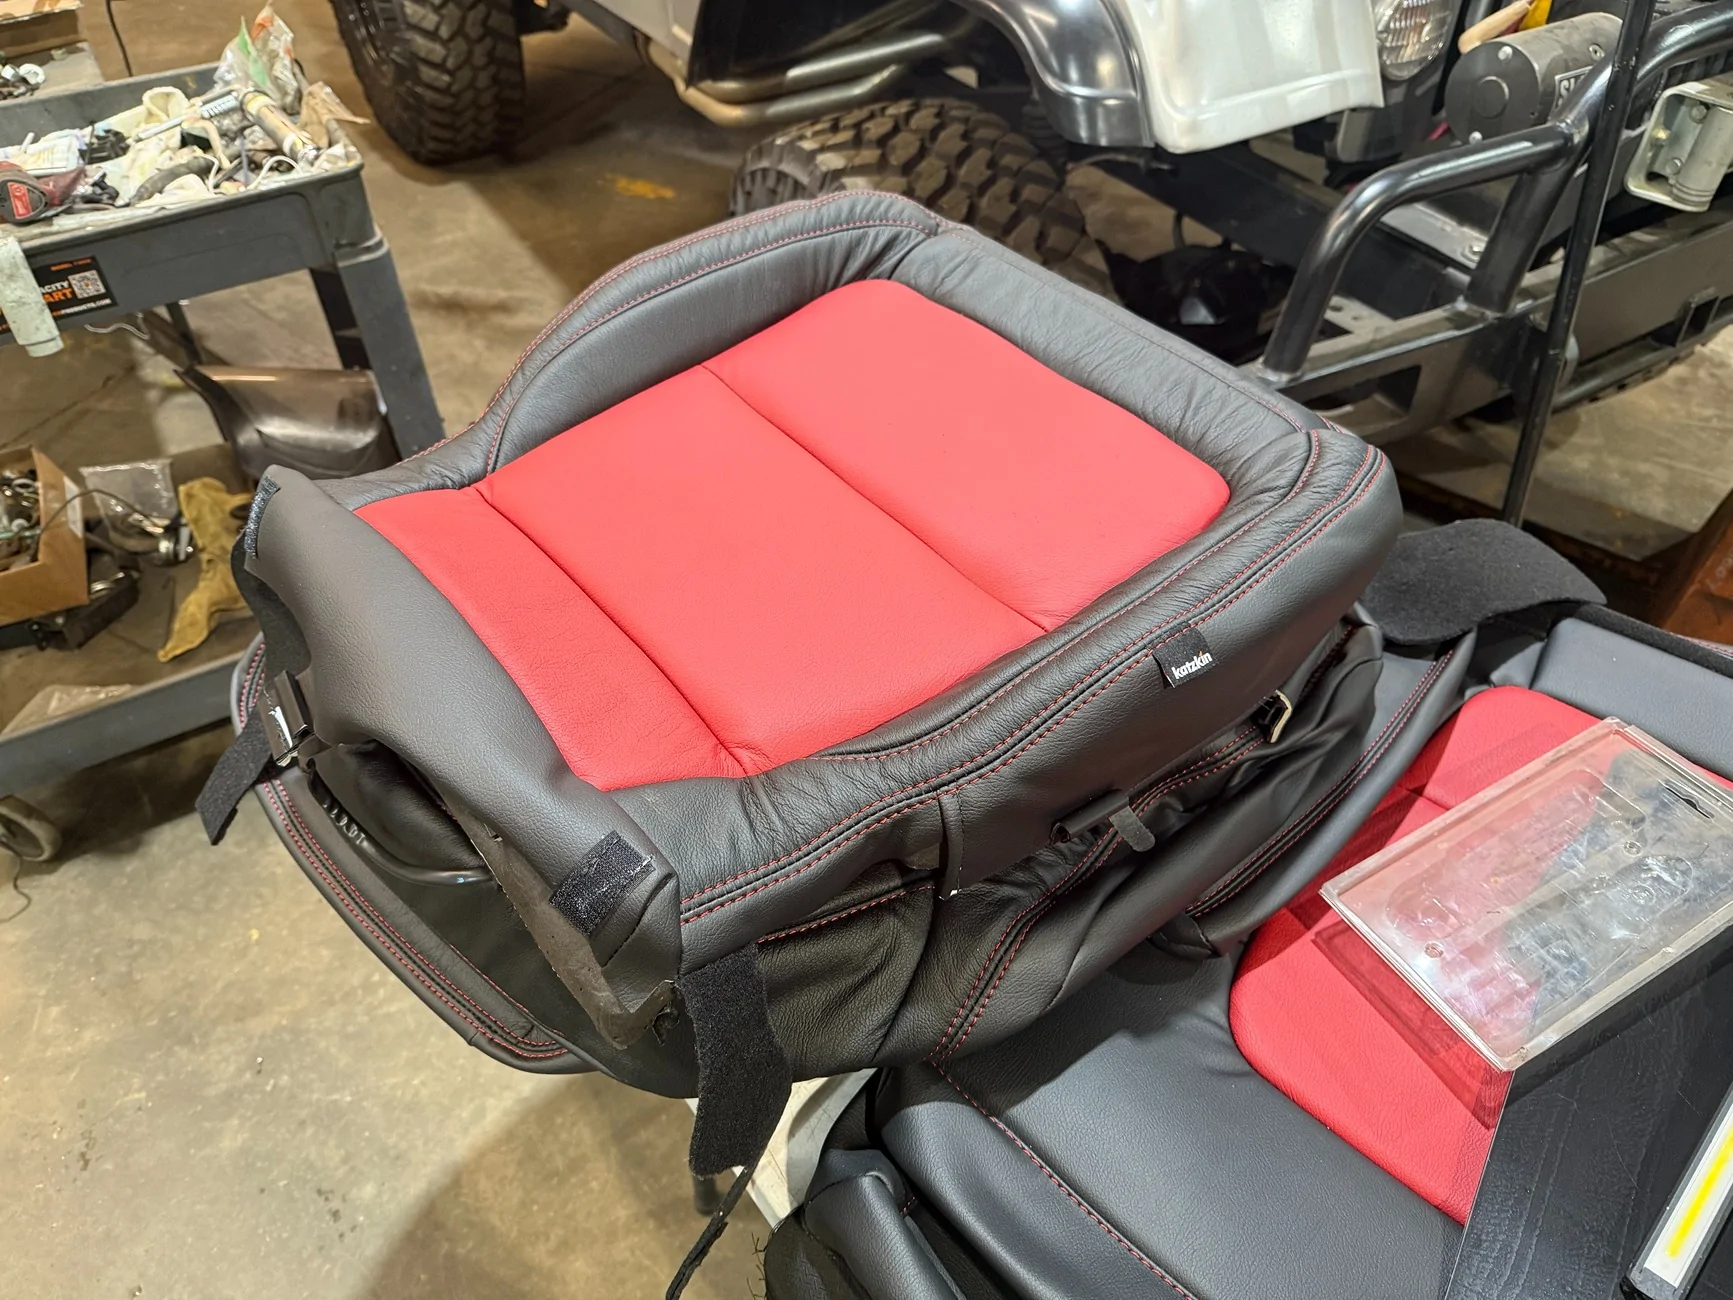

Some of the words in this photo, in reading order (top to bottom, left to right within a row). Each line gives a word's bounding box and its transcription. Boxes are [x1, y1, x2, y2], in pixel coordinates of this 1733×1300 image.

[39, 280, 70, 294] ACITY
[42, 288, 73, 303] ART
[1171, 650, 1213, 679] katzkin
